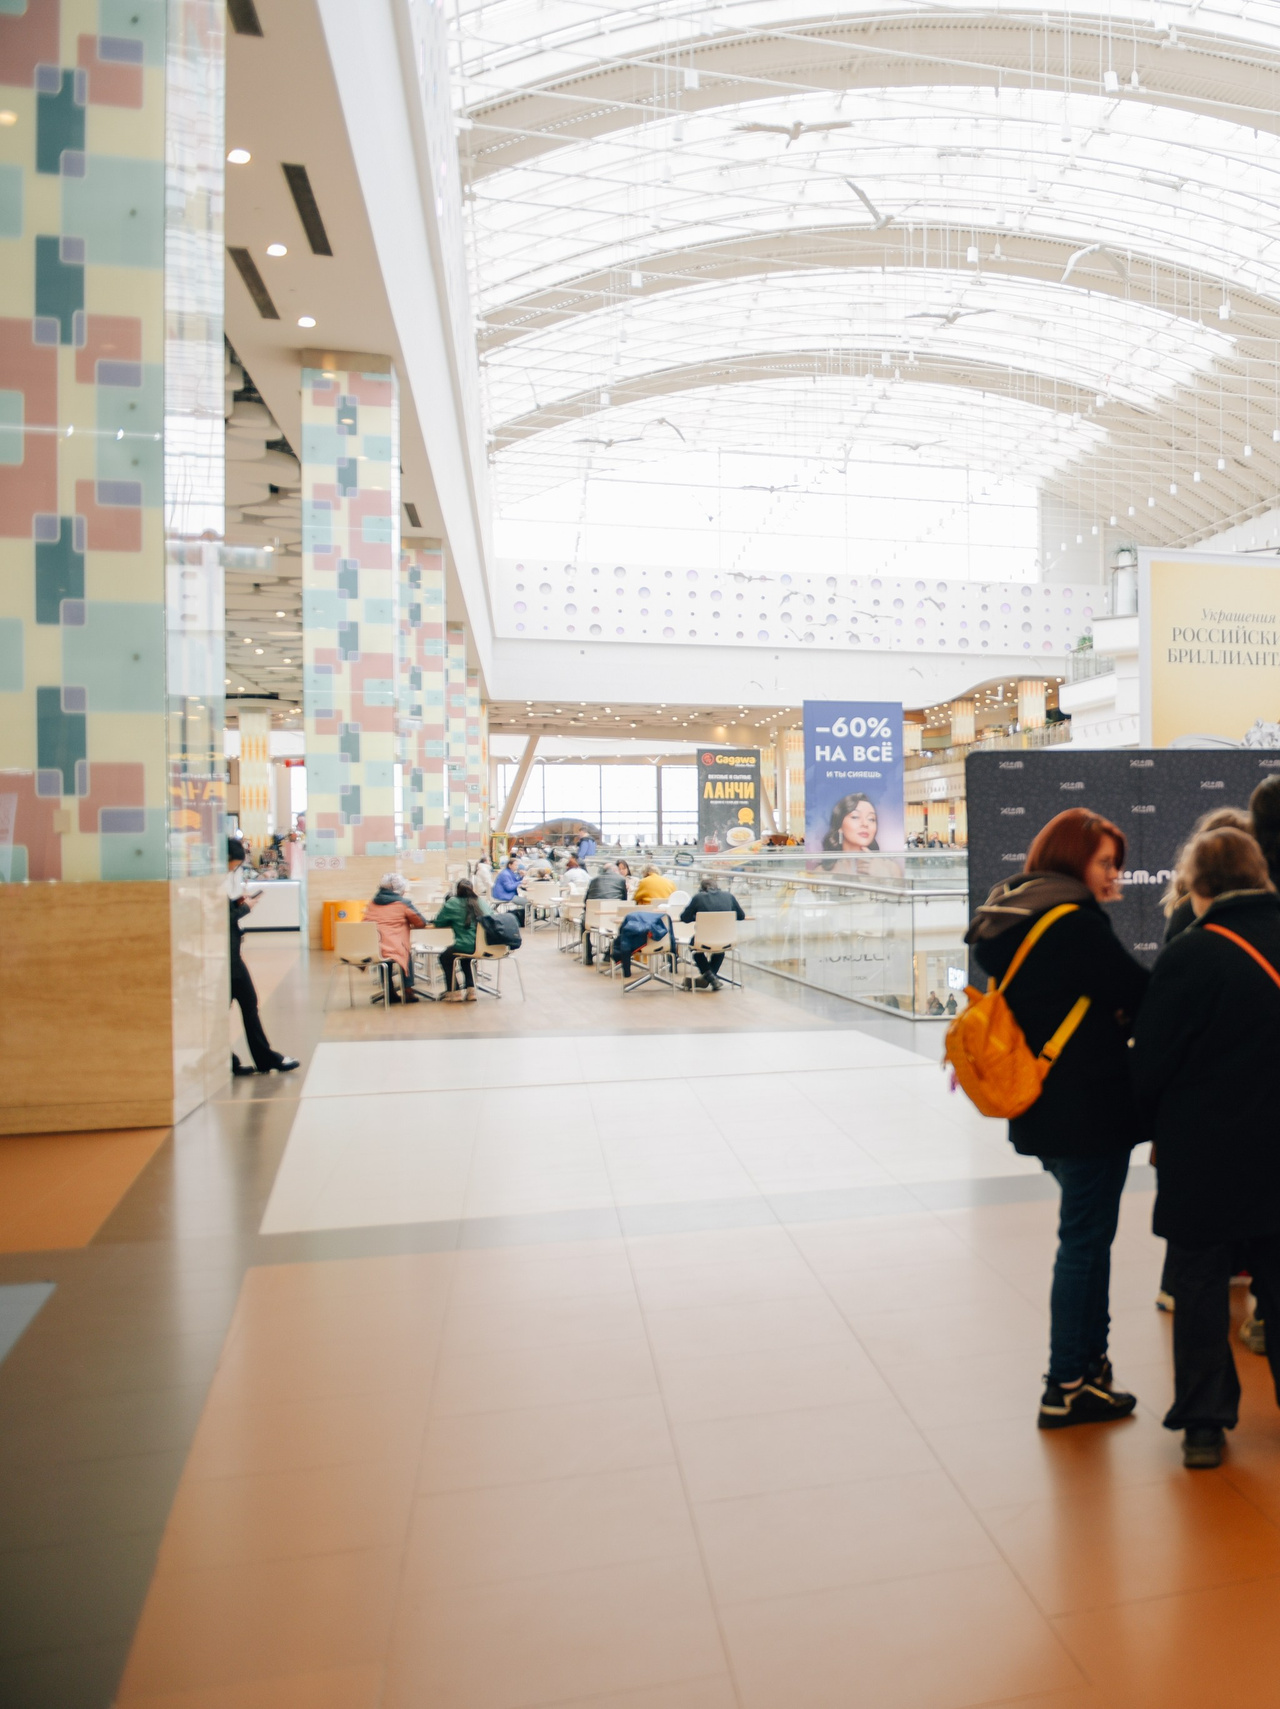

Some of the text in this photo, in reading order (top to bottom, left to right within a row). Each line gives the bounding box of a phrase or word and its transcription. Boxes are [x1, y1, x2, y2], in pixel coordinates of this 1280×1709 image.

[1201, 608, 1275, 624] Украшения
[715, 754, 757, 766] Gagawa
[816, 741, 893, 762] НА ВСЁ
[703, 781, 755, 799] ЛАНЧИ
